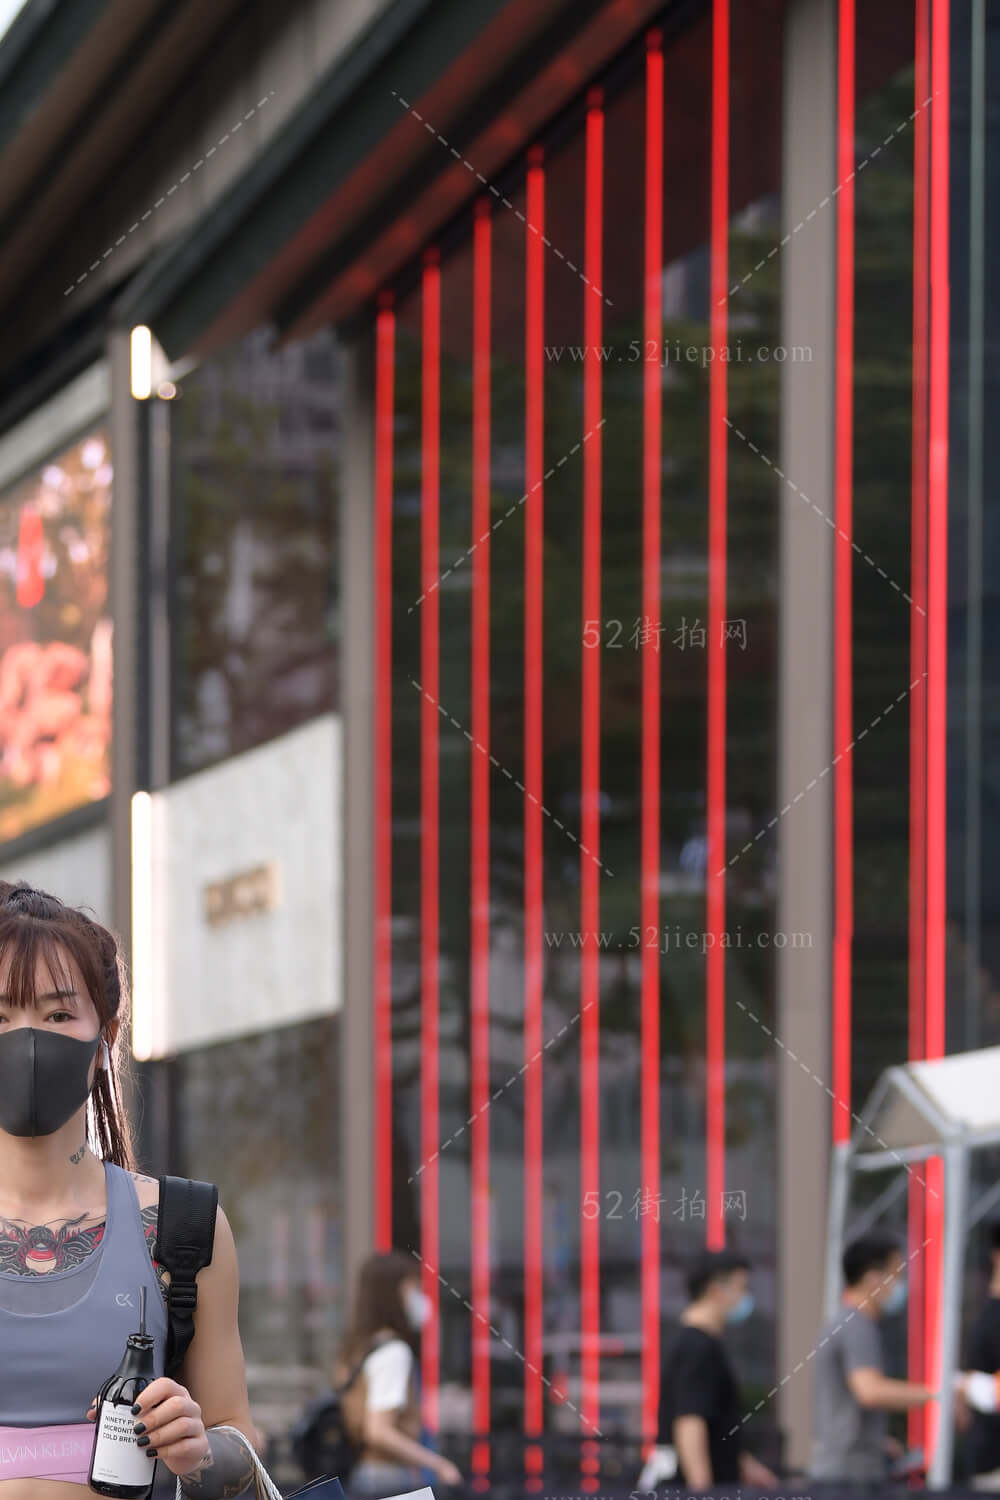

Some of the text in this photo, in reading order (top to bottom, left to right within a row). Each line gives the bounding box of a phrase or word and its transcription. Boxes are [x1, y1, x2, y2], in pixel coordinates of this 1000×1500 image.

[105, 1415, 126, 1425] NINETY
[104, 1423, 135, 1435] MICRONIT
[103, 1432, 118, 1441] COLD
[40, 1439, 87, 1458] KLEIN
